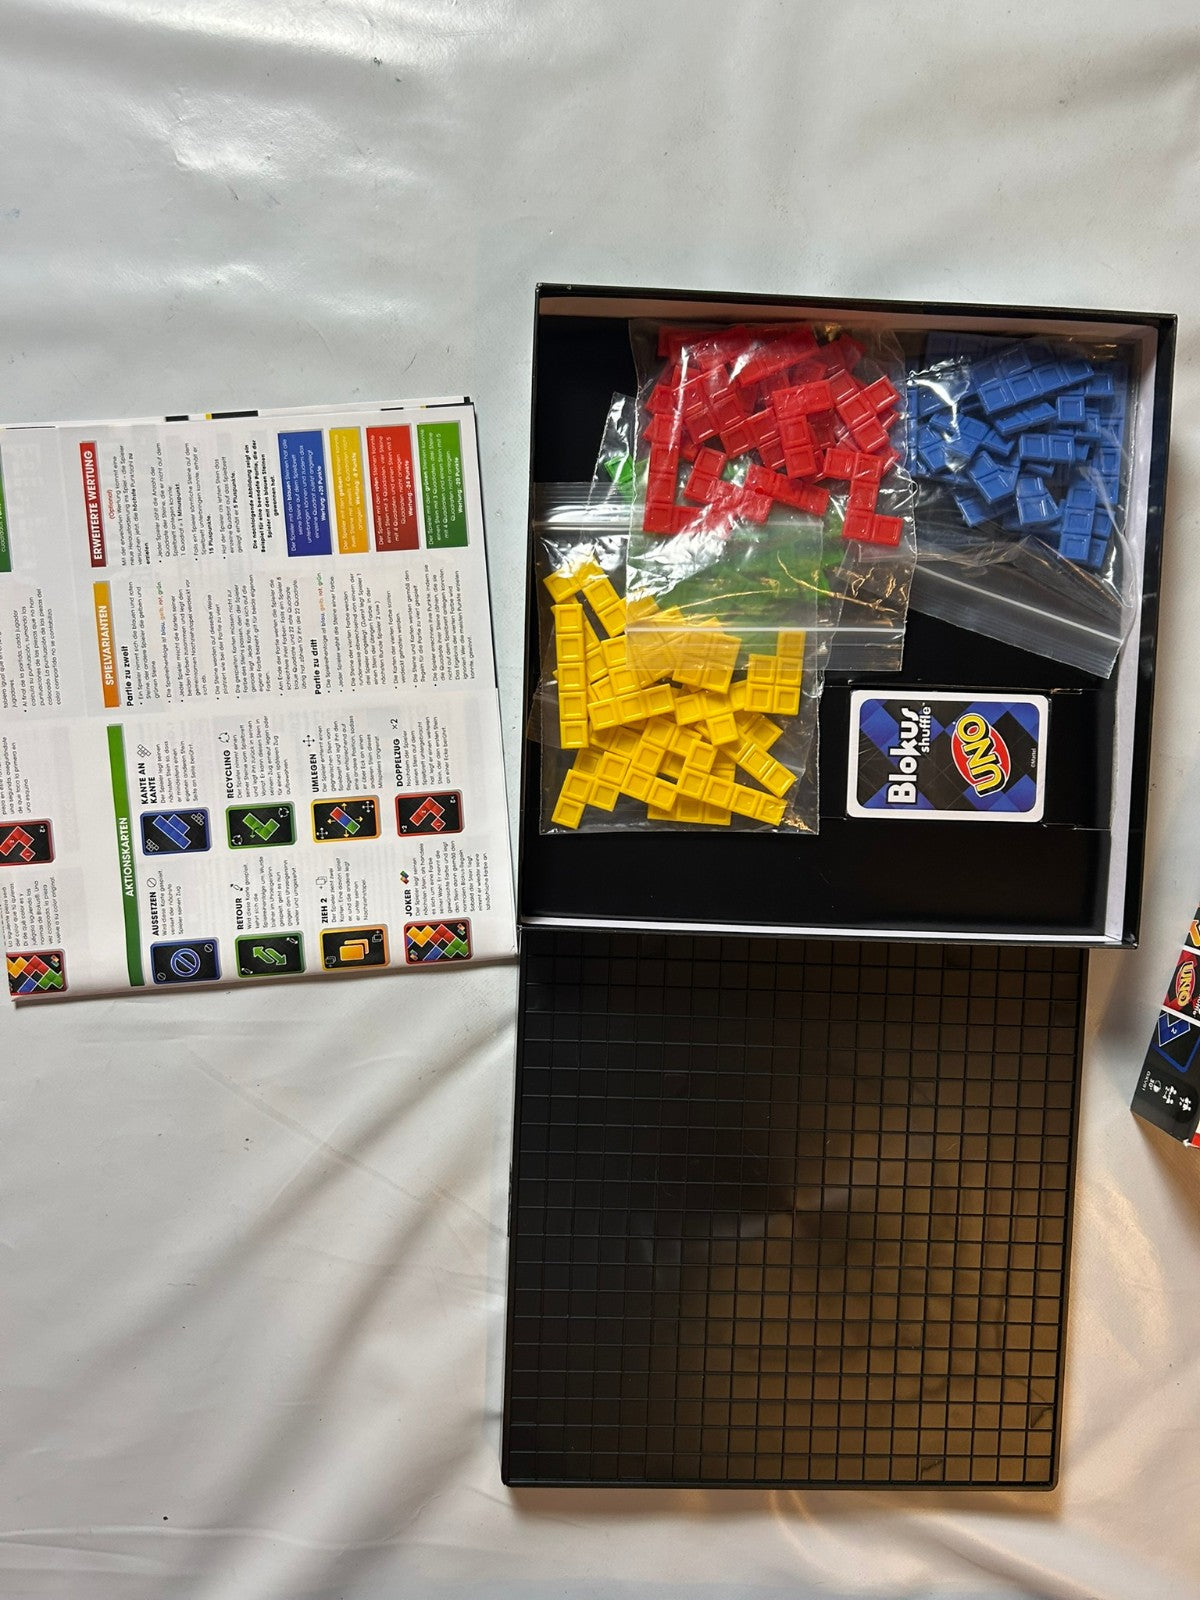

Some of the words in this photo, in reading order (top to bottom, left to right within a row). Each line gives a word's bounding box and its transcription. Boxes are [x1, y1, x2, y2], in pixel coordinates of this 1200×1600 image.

[84, 450, 96, 500] WERTUNG
[245, 469, 254, 498] Abbildung
[107, 488, 116, 519] (Optional)
[248, 499, 257, 538] nachfolgende
[89, 502, 102, 559] ERWEITERTE
[206, 513, 214, 546] Pluspunkte.
[258, 530, 266, 552] Beispiel
[99, 605, 114, 685] SPIELVARIANTEN
[121, 645, 129, 667] zweit
[125, 669, 130, 678] zu
[313, 658, 319, 667] zu
[124, 681, 133, 706] Partie
[313, 669, 321, 694] Partie
[138, 762, 146, 774] AN
[393, 738, 402, 786] DOPPELZUG
[887, 707, 921, 803] Blokus
[955, 713, 1005, 795] UNO
[224, 749, 234, 798] RECYCLING
[310, 753, 318, 792] UMLEGEN
[139, 777, 148, 804] KANTE
[148, 776, 157, 803] KANTE
[119, 817, 135, 896] AKTIONSKARTEN
[150, 891, 159, 936] AUSSETZEN
[235, 897, 244, 929] RETOUR
[1178, 961, 1194, 1007] UNO
